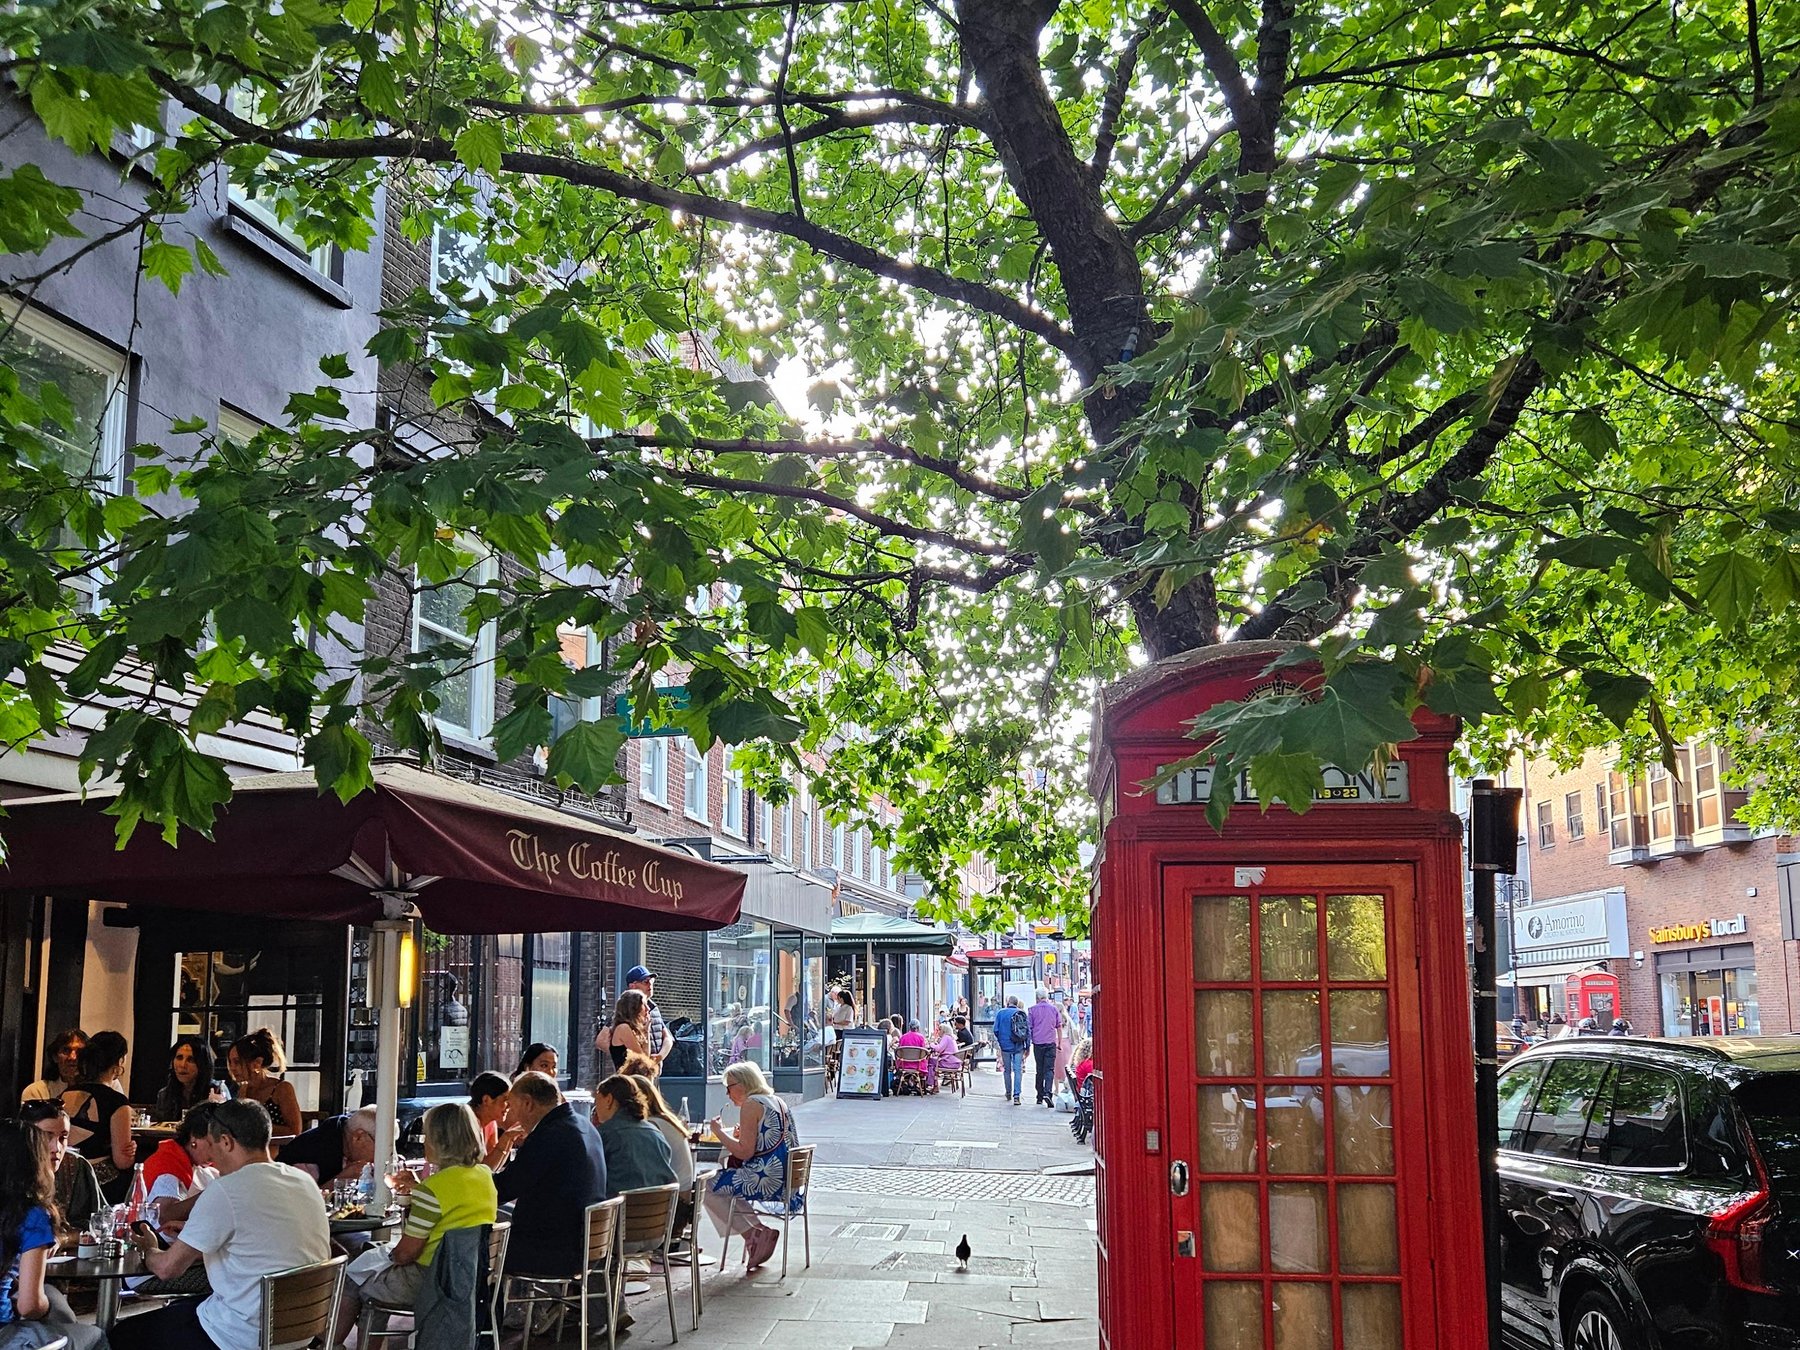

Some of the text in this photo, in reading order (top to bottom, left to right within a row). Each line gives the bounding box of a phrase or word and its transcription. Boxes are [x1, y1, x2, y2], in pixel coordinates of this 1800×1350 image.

[1342, 788, 1358, 799] 23
[505, 829, 684, 908] The Coffee Cup
[1544, 911, 1585, 932] Amorino
[1648, 913, 1747, 944] Sainsbury's Local
